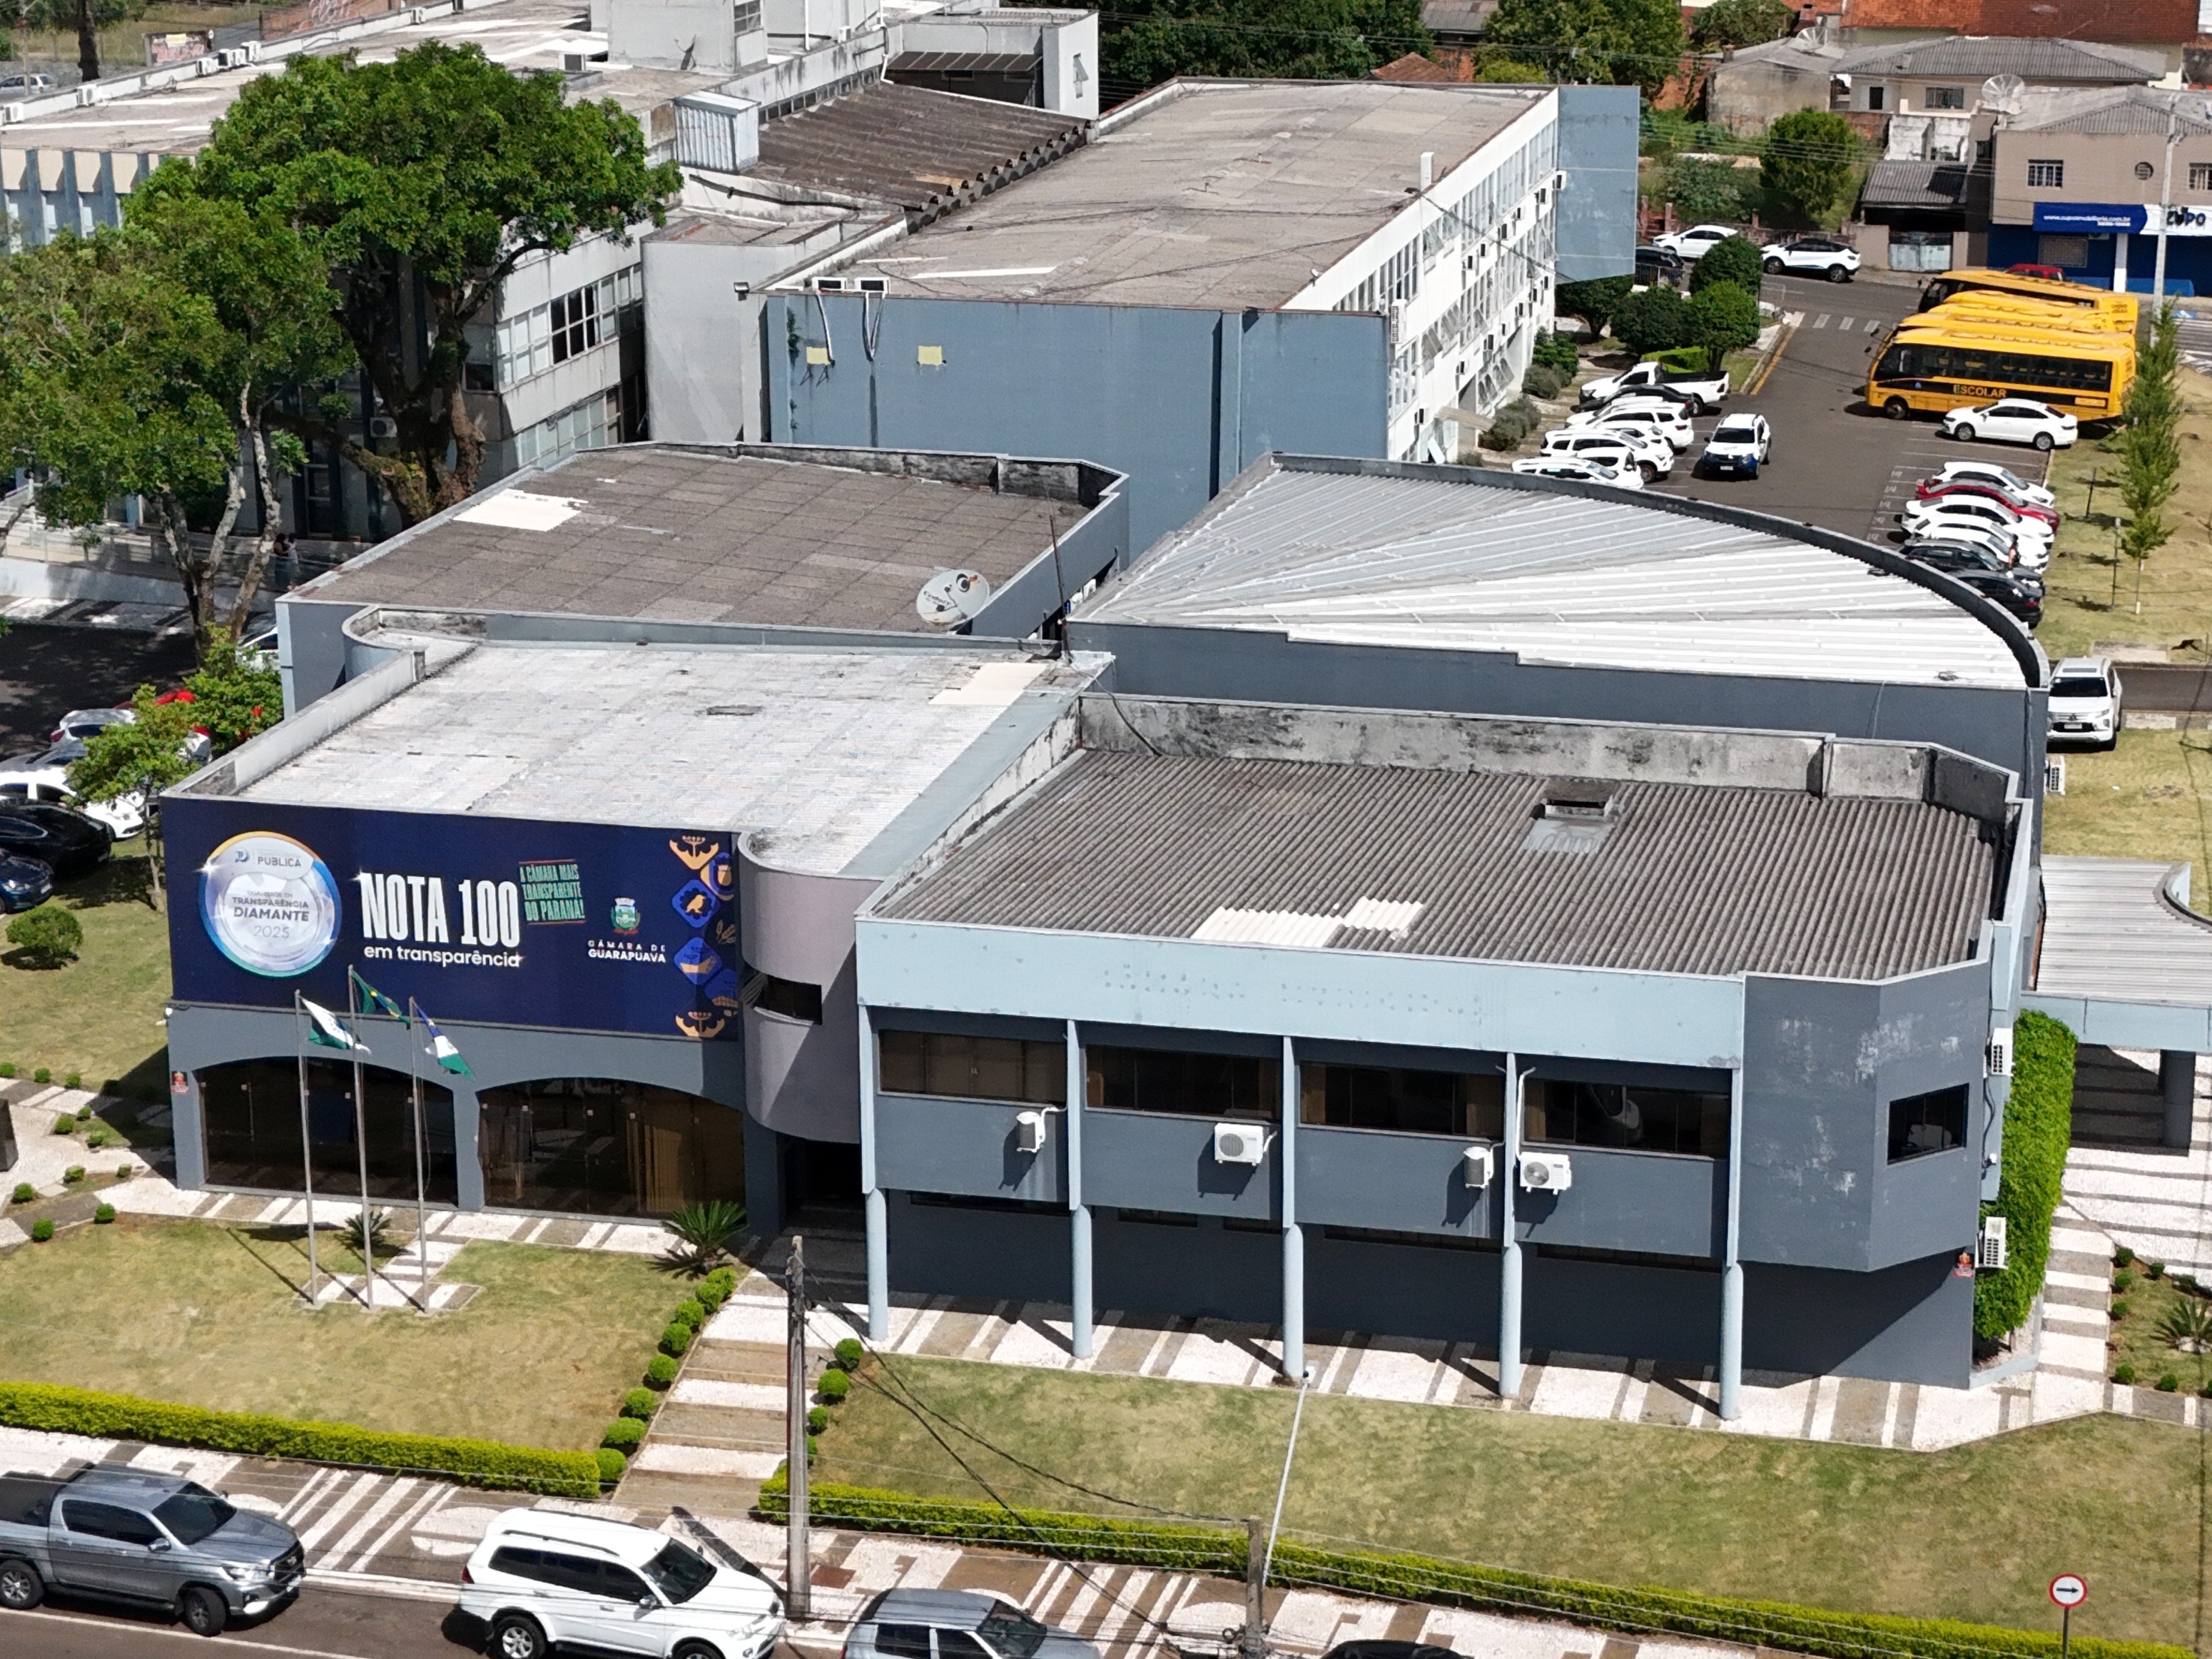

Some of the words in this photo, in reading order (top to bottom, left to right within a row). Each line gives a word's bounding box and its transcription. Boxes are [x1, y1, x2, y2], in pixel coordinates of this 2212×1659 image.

[519, 866, 526, 883] A
[233, 906, 310, 922] DIAMANTE
[360, 872, 450, 943] NOTA
[458, 879, 520, 948] 100
[524, 901, 539, 921] DO
[253, 925, 290, 939] 2025
[364, 945, 392, 960] em
[397, 945, 522, 968] transparência
[588, 948, 666, 963] GUARAPUAVA
